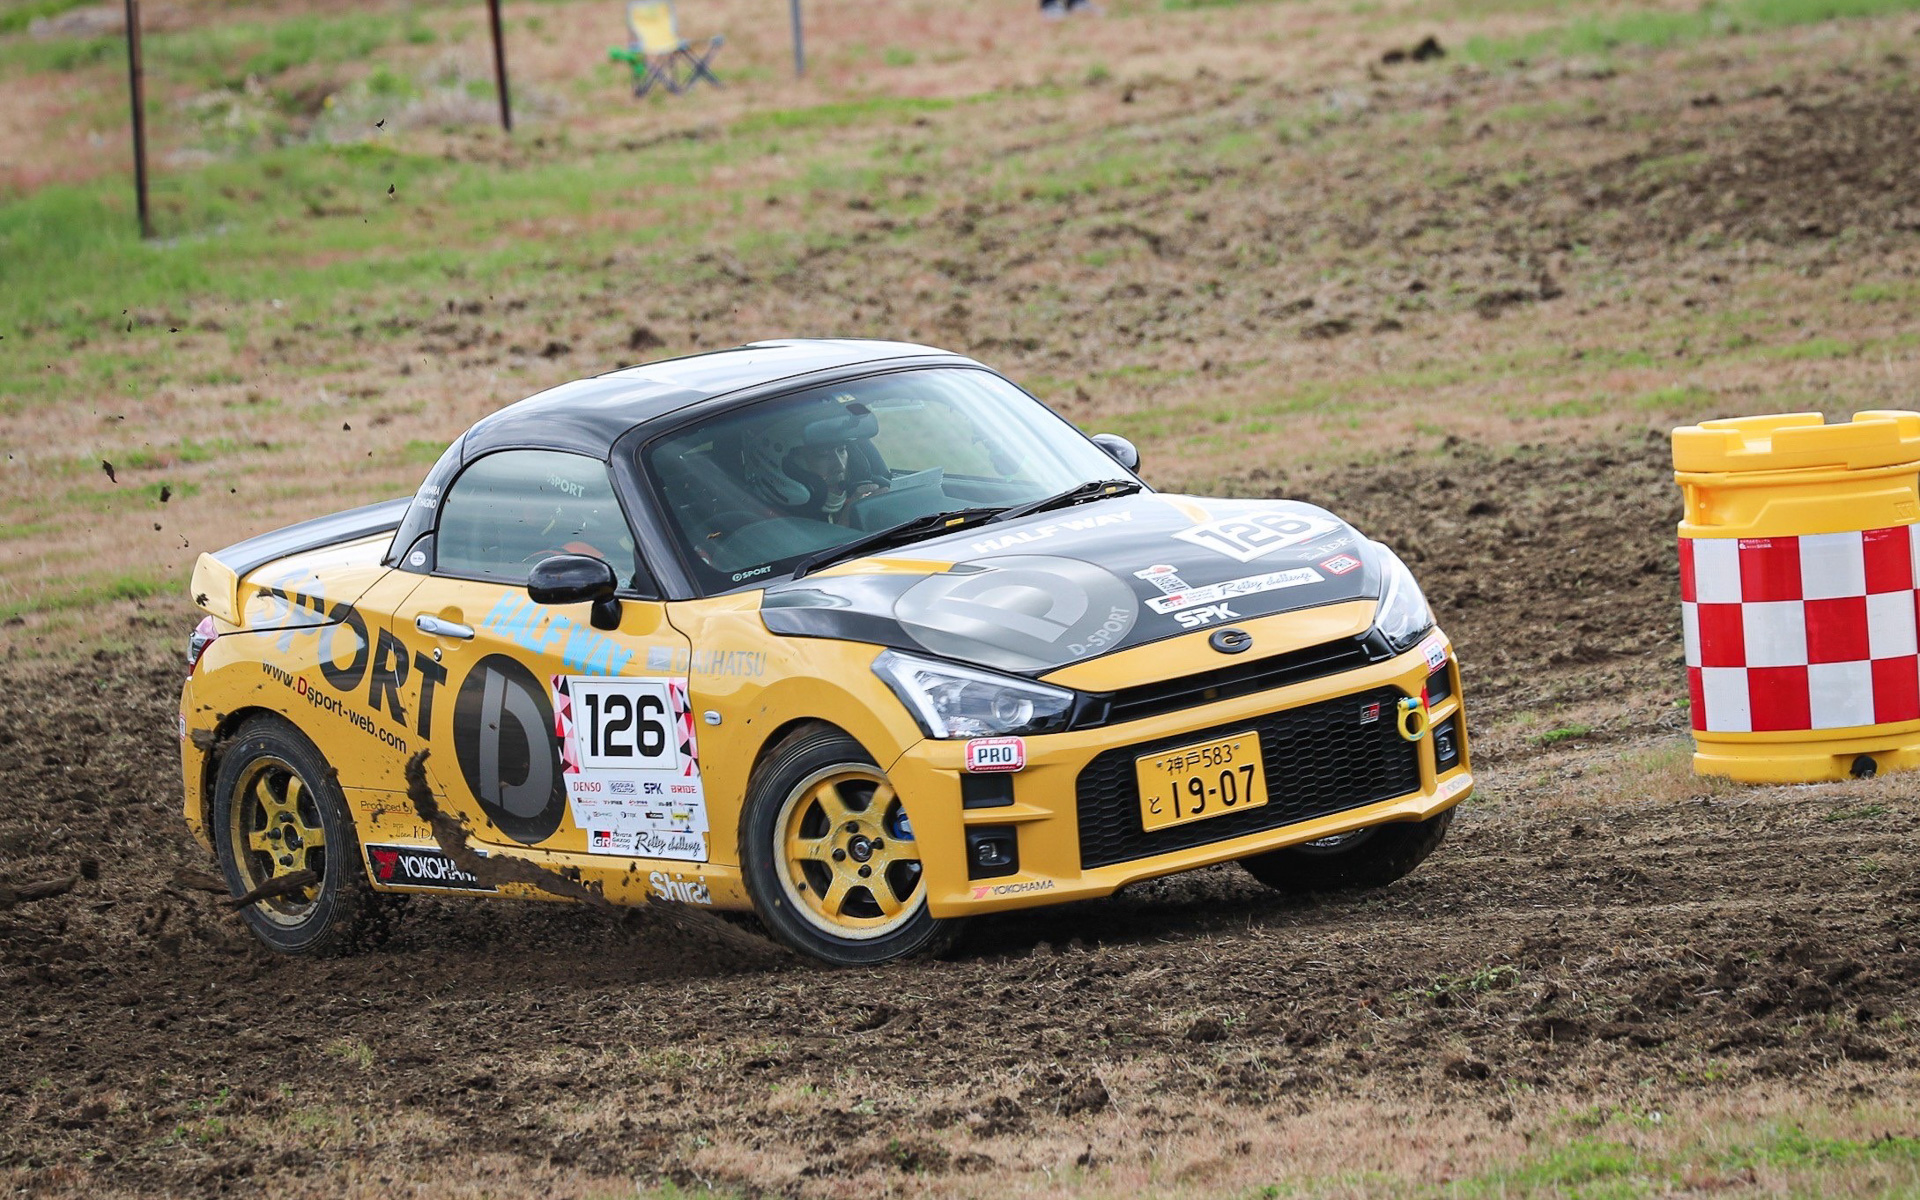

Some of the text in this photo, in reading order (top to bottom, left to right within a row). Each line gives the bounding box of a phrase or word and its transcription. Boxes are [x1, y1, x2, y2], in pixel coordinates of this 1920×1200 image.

[551, 475, 585, 498] SPORT
[1195, 515, 1311, 553] 126
[742, 565, 772, 579] SPORT
[1173, 602, 1242, 629] SPK
[482, 589, 636, 677] HALF WAY
[1066, 606, 1130, 656] D-SPORT
[250, 567, 448, 742] SPORT
[675, 648, 767, 677] DAIHATSU
[262, 660, 407, 755] www.Dsport-web.com
[585, 694, 665, 757] 126
[978, 746, 1012, 763] PRO
[573, 781, 697, 795] DENSO SPK BRIDE
[1148, 763, 1255, 819] と 19-07
[360, 800, 402, 812] Produced
[413, 824, 433, 840] KD
[593, 836, 611, 848] GR
[398, 855, 478, 883] YOKOHA
[991, 879, 1055, 895] YOKOHAMA
